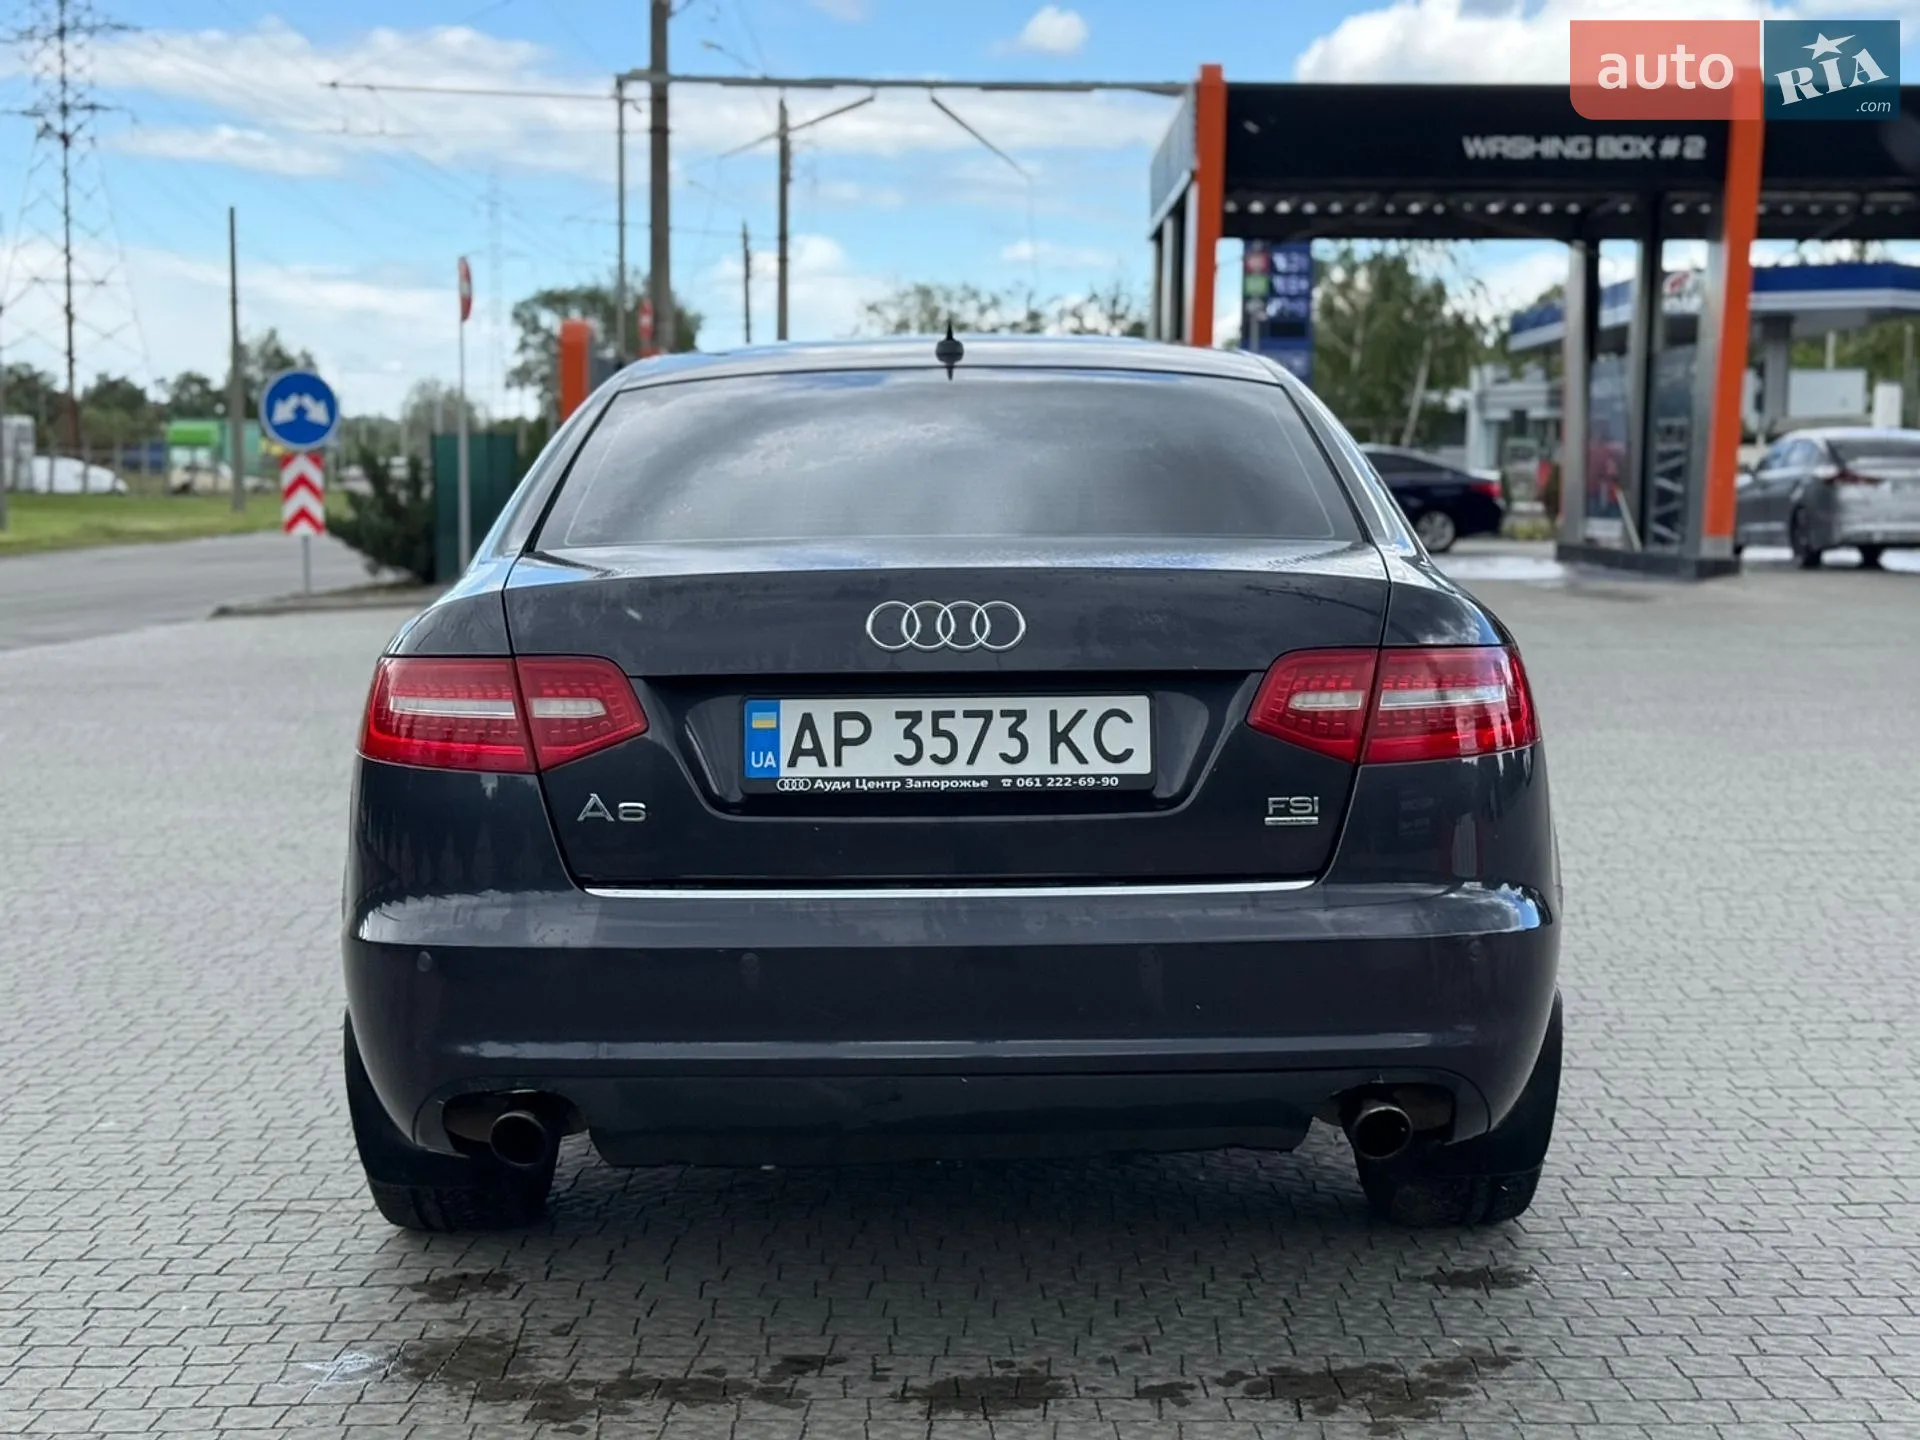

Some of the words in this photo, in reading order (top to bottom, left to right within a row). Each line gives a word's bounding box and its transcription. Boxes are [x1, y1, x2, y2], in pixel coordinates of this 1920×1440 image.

[1462, 135, 1592, 160] WASHING
[1596, 135, 1655, 160] BOX
[787, 711, 872, 768] AP
[893, 709, 1029, 766] 3573
[1049, 707, 1135, 765] KC
[751, 751, 777, 768] UA
[813, 779, 851, 793] Ауди
[855, 778, 901, 793] Центр
[905, 777, 989, 792] Запорожье
[1016, 776, 1042, 788] 061
[1046, 775, 1120, 788] 222-69-90
[577, 793, 647, 822] A6
